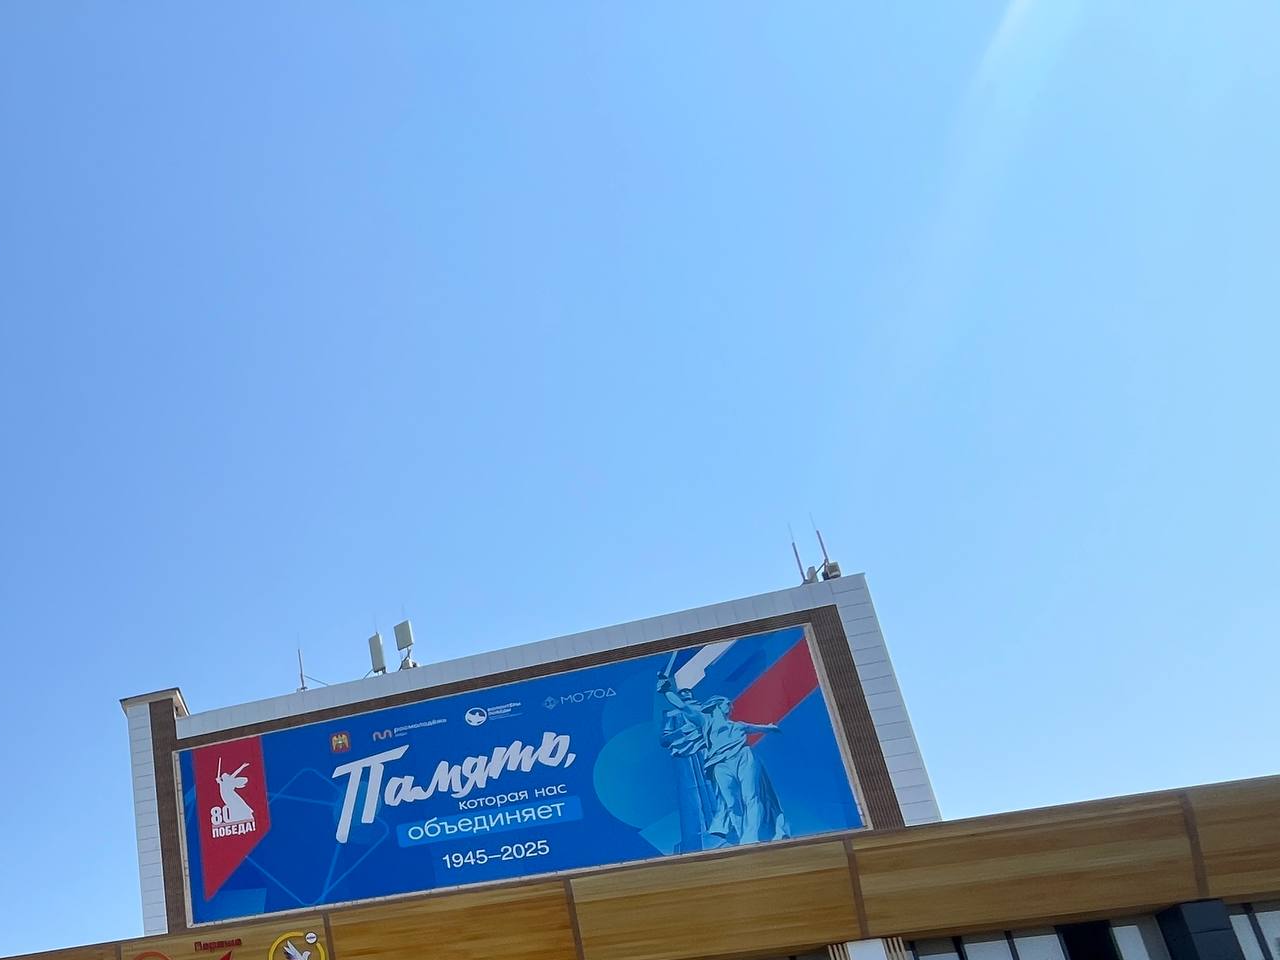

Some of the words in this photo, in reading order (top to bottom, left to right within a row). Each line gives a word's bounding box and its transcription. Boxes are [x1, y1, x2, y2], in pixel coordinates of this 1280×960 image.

[331, 731, 577, 844] Память,
[458, 789, 529, 811] которая
[534, 782, 568, 798] нас
[212, 821, 256, 839] ПОБЕДА!
[407, 801, 566, 841] объединяет
